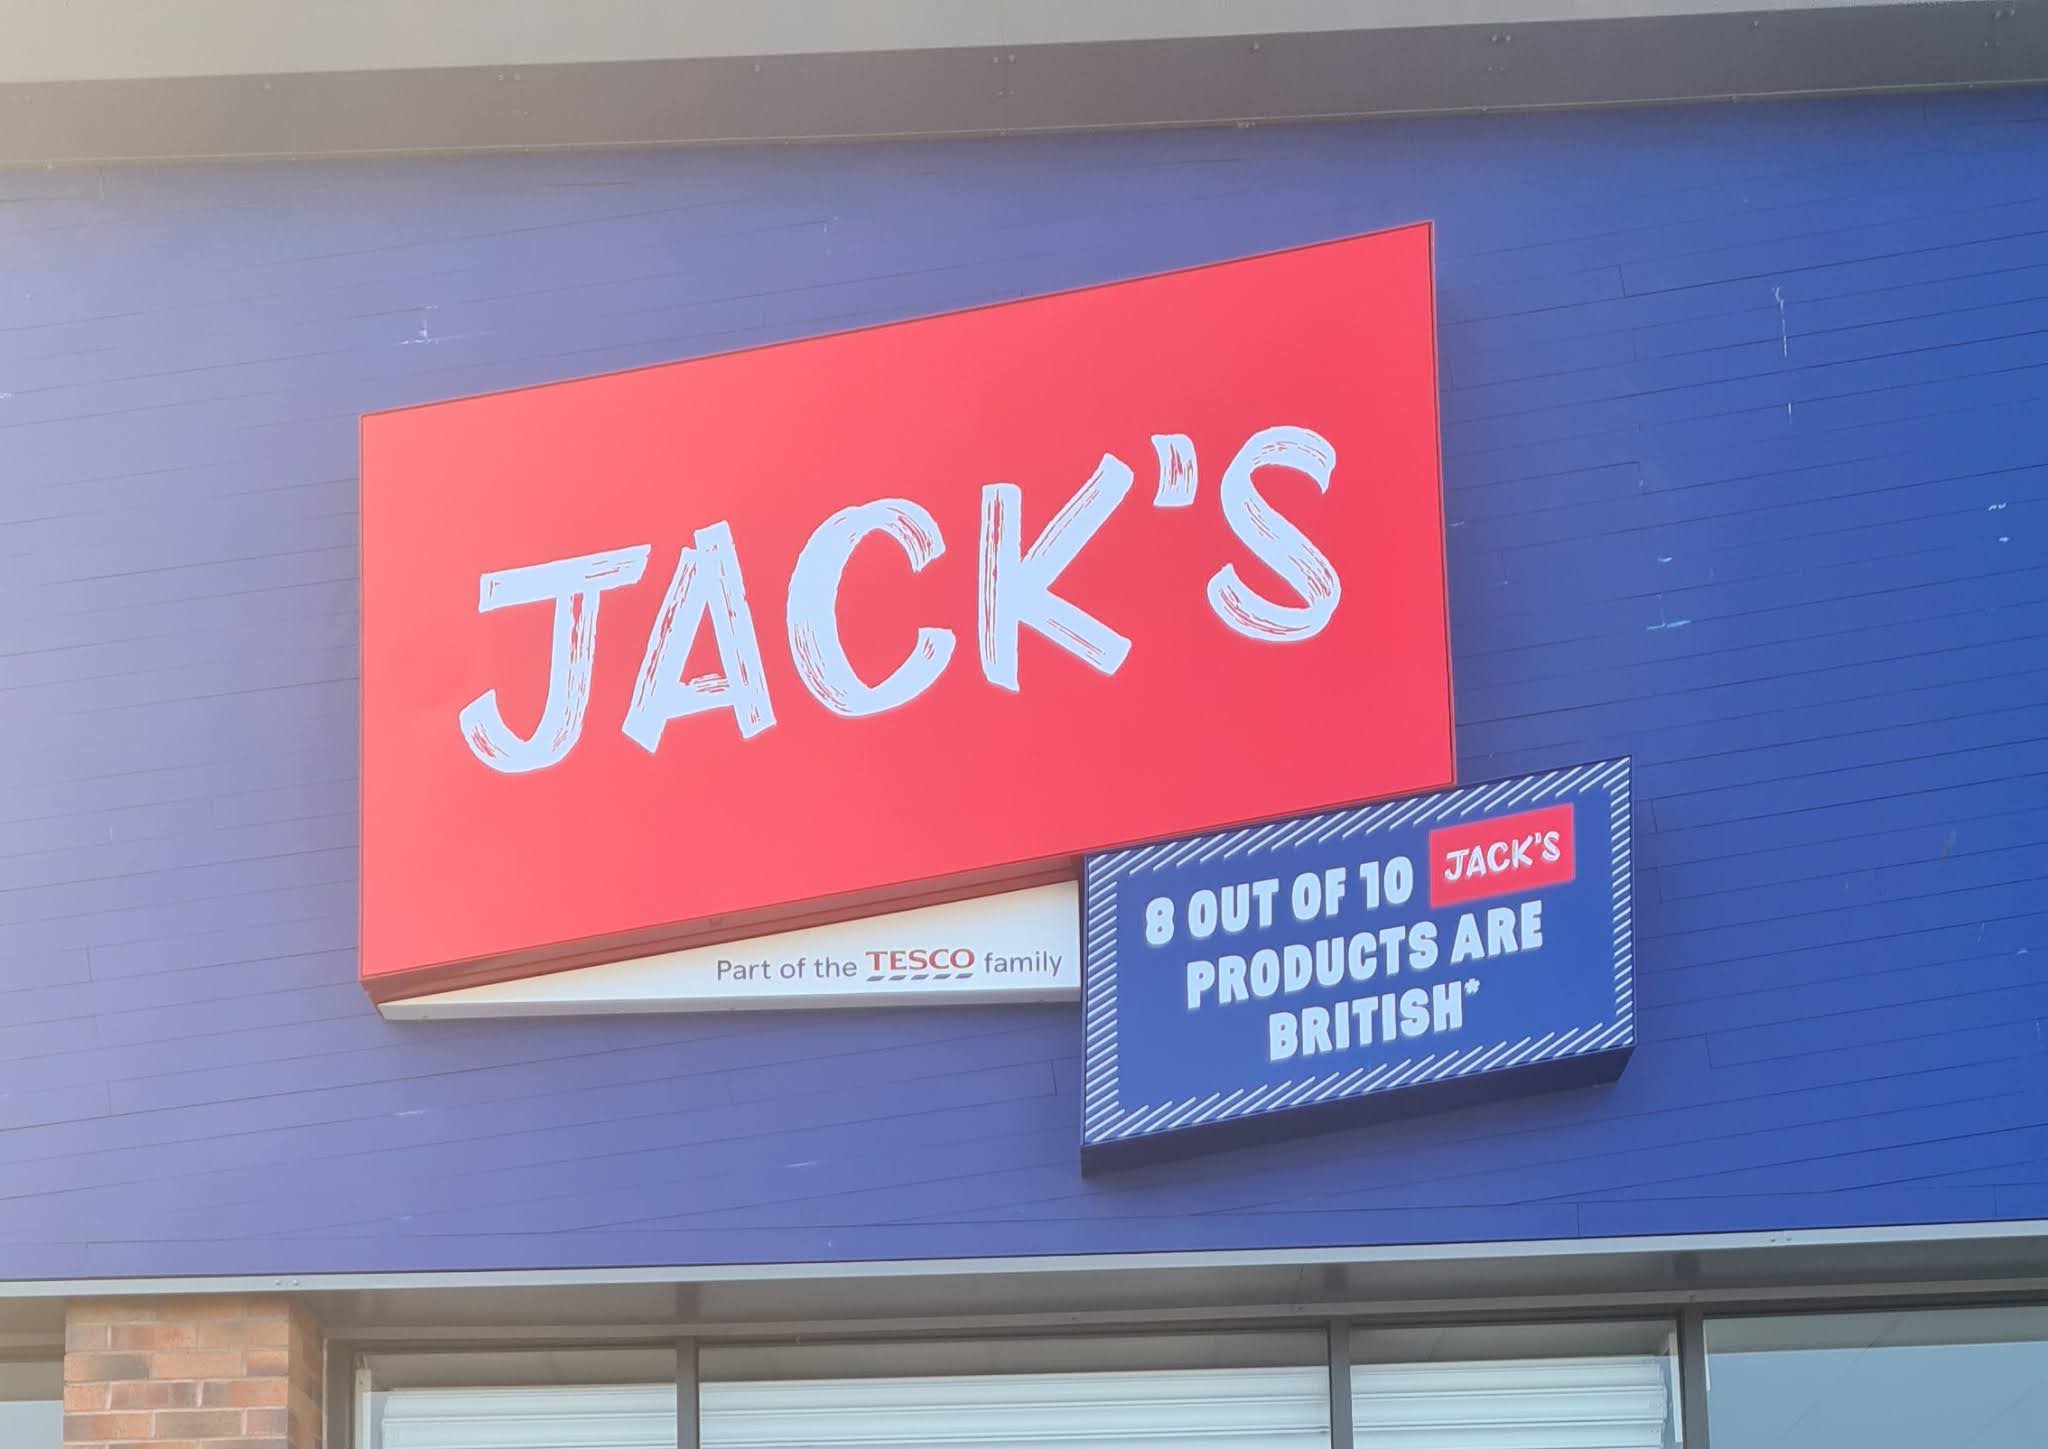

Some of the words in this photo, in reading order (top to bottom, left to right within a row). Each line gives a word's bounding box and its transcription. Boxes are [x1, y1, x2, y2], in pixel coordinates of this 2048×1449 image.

[459, 425, 1342, 773] JACK'S
[1144, 896, 1175, 946] 8
[1187, 877, 1280, 938] OUT
[1291, 867, 1347, 921] OF
[1358, 856, 1414, 909] 10
[1444, 831, 1562, 882] JACK'S
[716, 956, 772, 981] Part
[779, 957, 806, 979] of
[814, 957, 858, 979] the
[864, 948, 976, 973] TESCO
[984, 950, 1063, 977] family
[1186, 921, 1439, 1010] PRODUCTS
[1450, 900, 1544, 963] ARE
